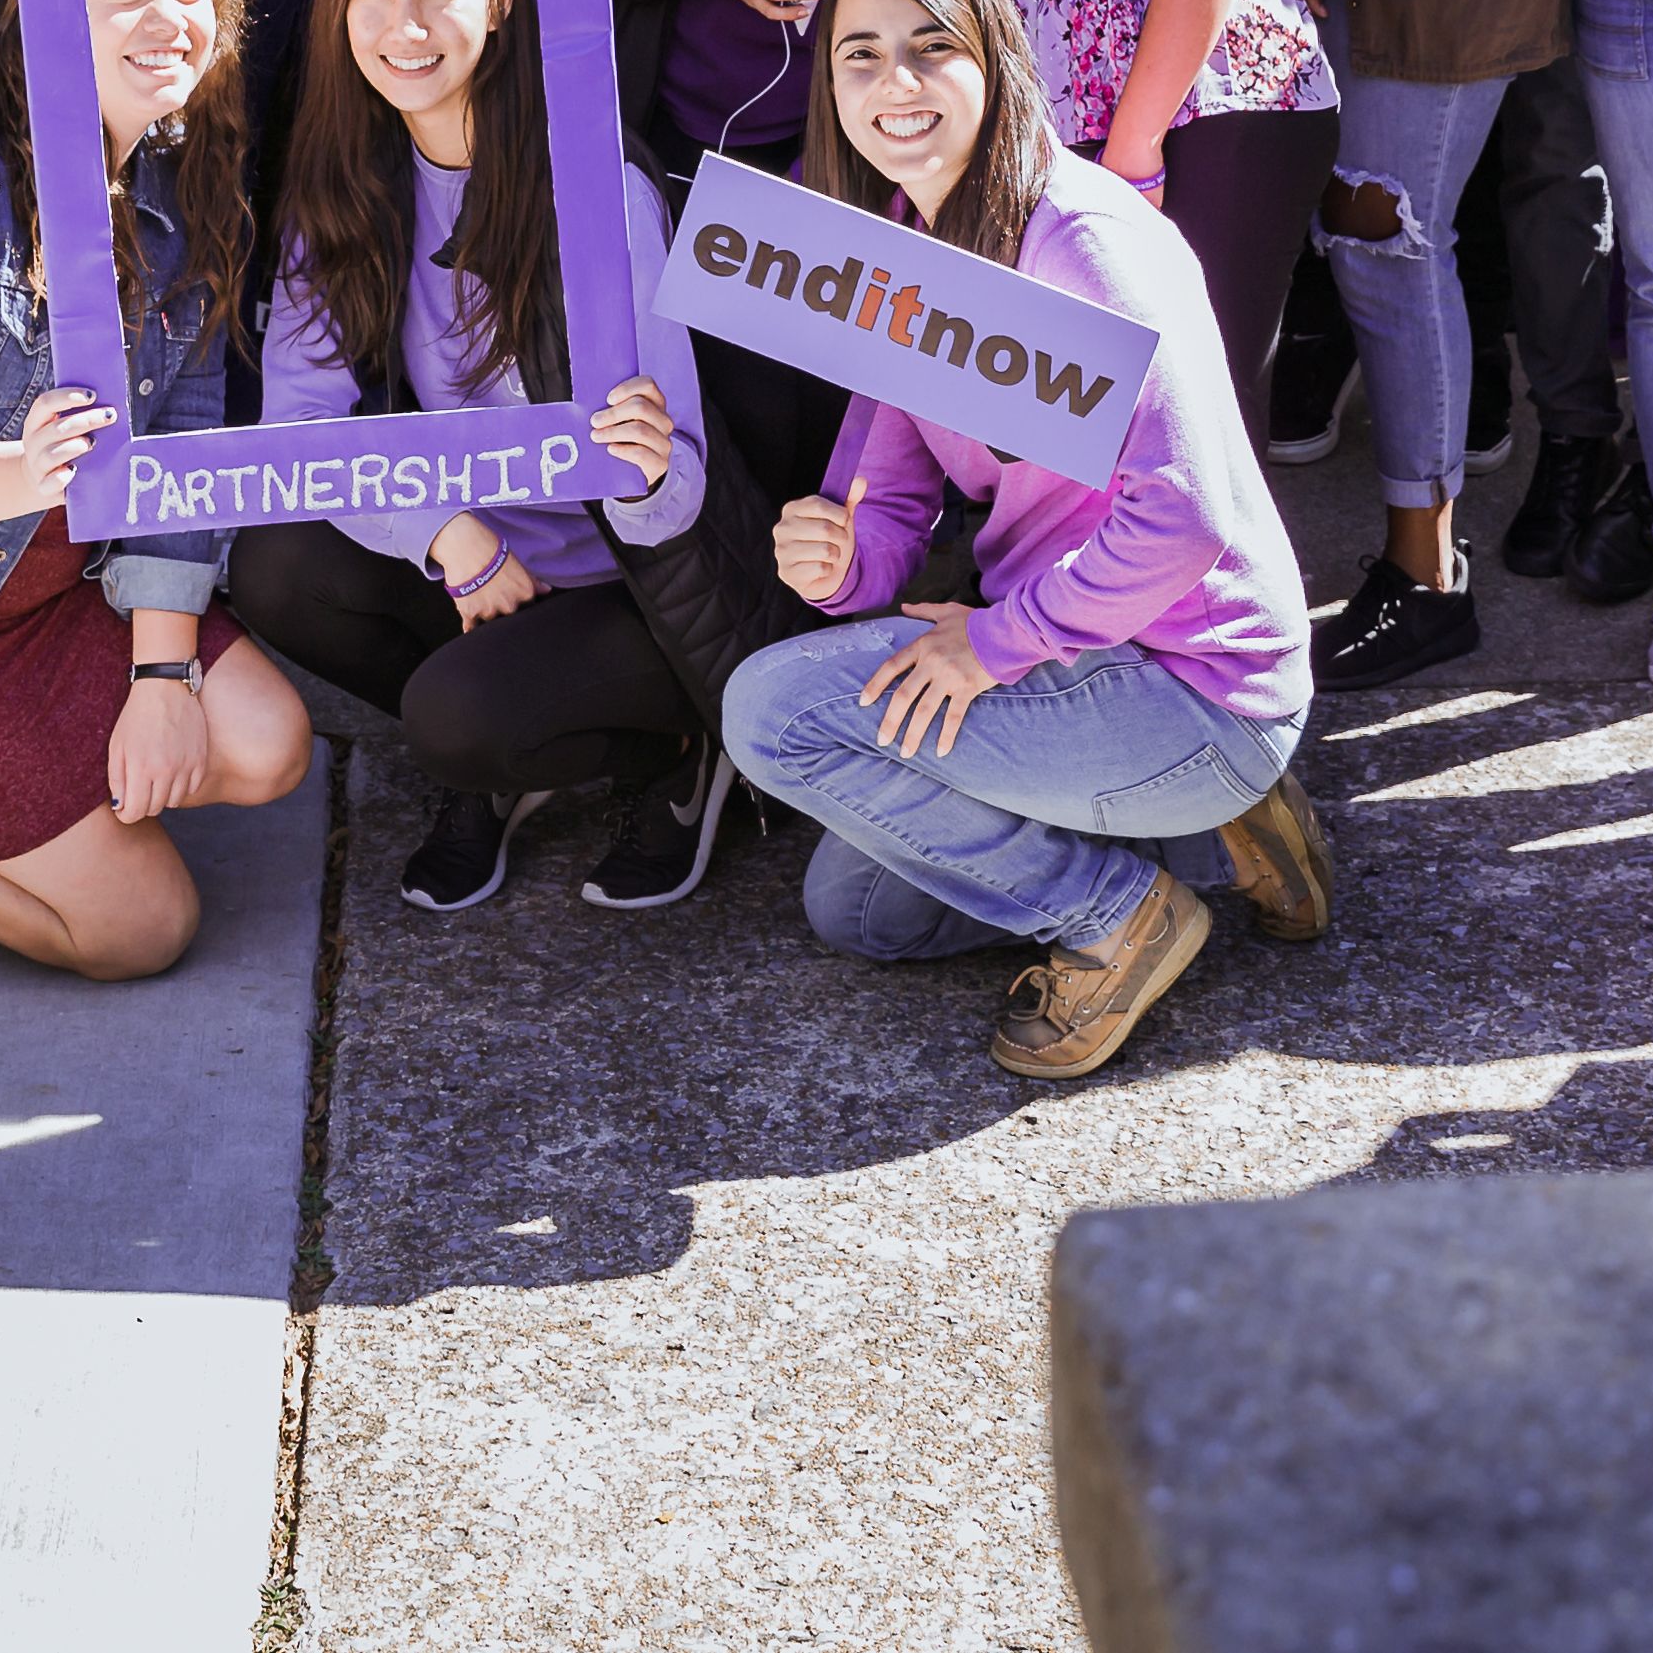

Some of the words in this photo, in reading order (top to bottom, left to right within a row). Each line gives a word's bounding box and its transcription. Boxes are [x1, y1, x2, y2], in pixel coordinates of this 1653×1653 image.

[692, 222, 1116, 419] enditnow
[125, 434, 580, 524] PARTNERSHIP
[459, 583, 478, 596] End
